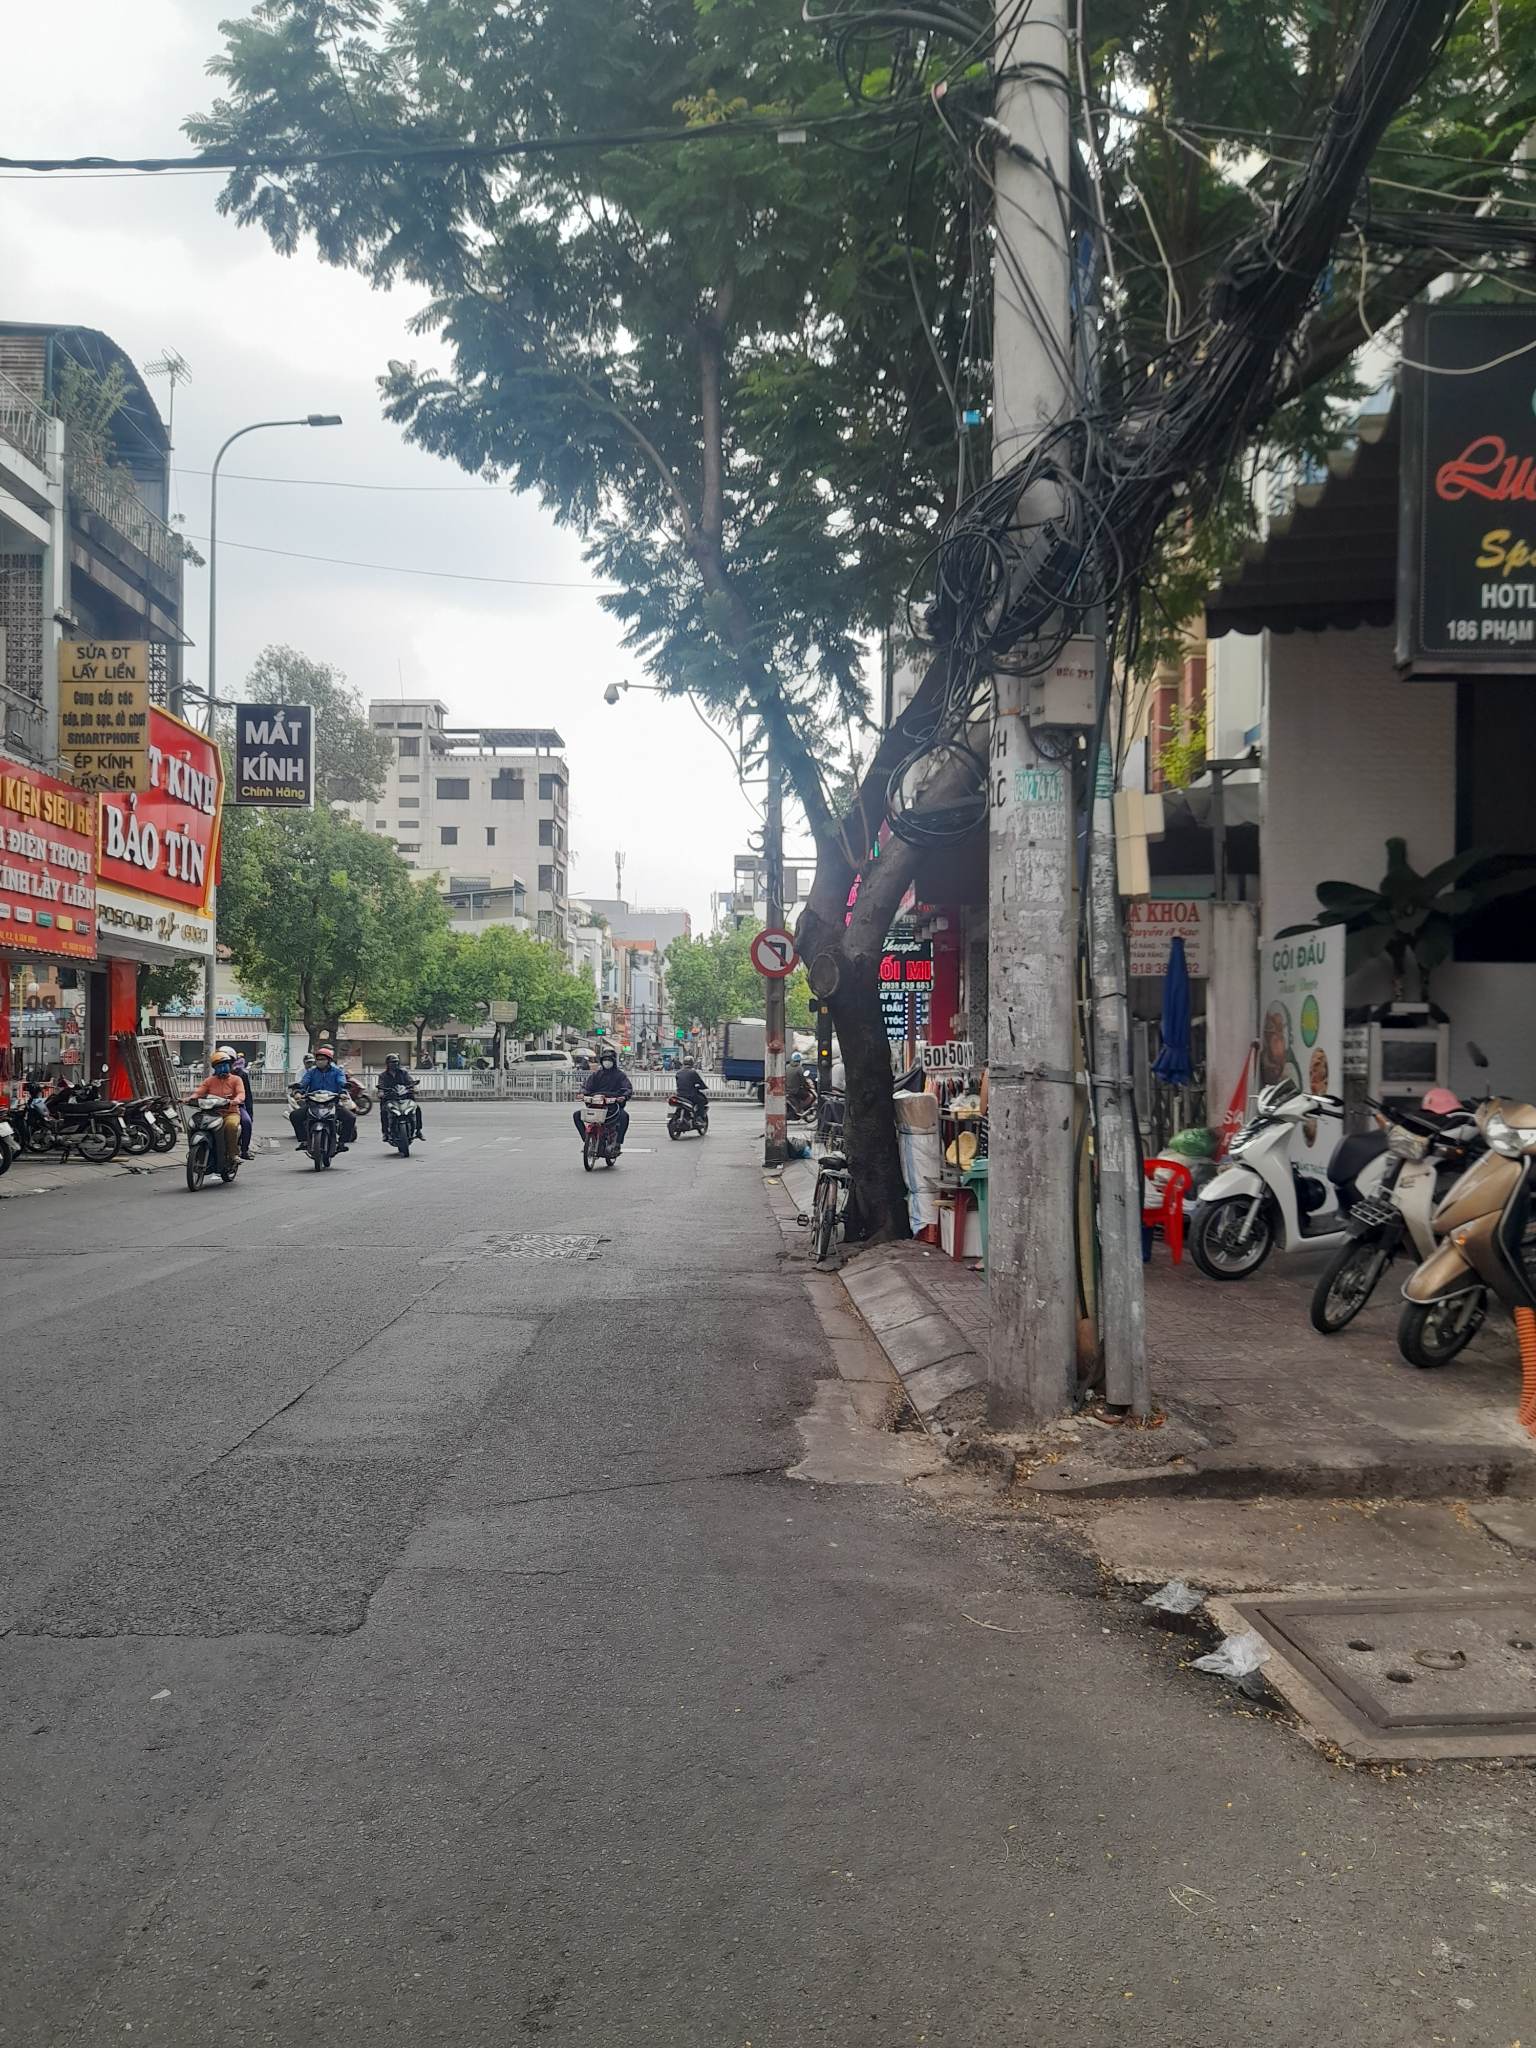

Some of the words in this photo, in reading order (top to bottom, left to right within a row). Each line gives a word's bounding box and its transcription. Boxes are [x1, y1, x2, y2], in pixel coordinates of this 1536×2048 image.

[1447, 619, 1478, 641] 186
[1480, 619, 1534, 645] PHẠM
[111, 646, 131, 660] ĐT
[72, 662, 98, 679] LẤY
[67, 732, 140, 745] SMARTPHONE
[245, 710, 302, 745] MẮT
[73, 752, 93, 769] ÉP
[97, 753, 134, 769] KÍNH
[242, 751, 304, 782] KÍNH
[167, 750, 217, 816] KÍNH
[5, 775, 41, 822] KIỆN
[42, 789, 75, 830] SIÊU
[7, 828, 48, 863] ĐIỆN
[48, 841, 92, 878] THOẠI
[106, 792, 160, 871] BẢO
[164, 823, 206, 887] TÍN
[1145, 902, 1200, 923] KHOA
[879, 954, 901, 980] ỐI
[905, 959, 932, 981] MI
